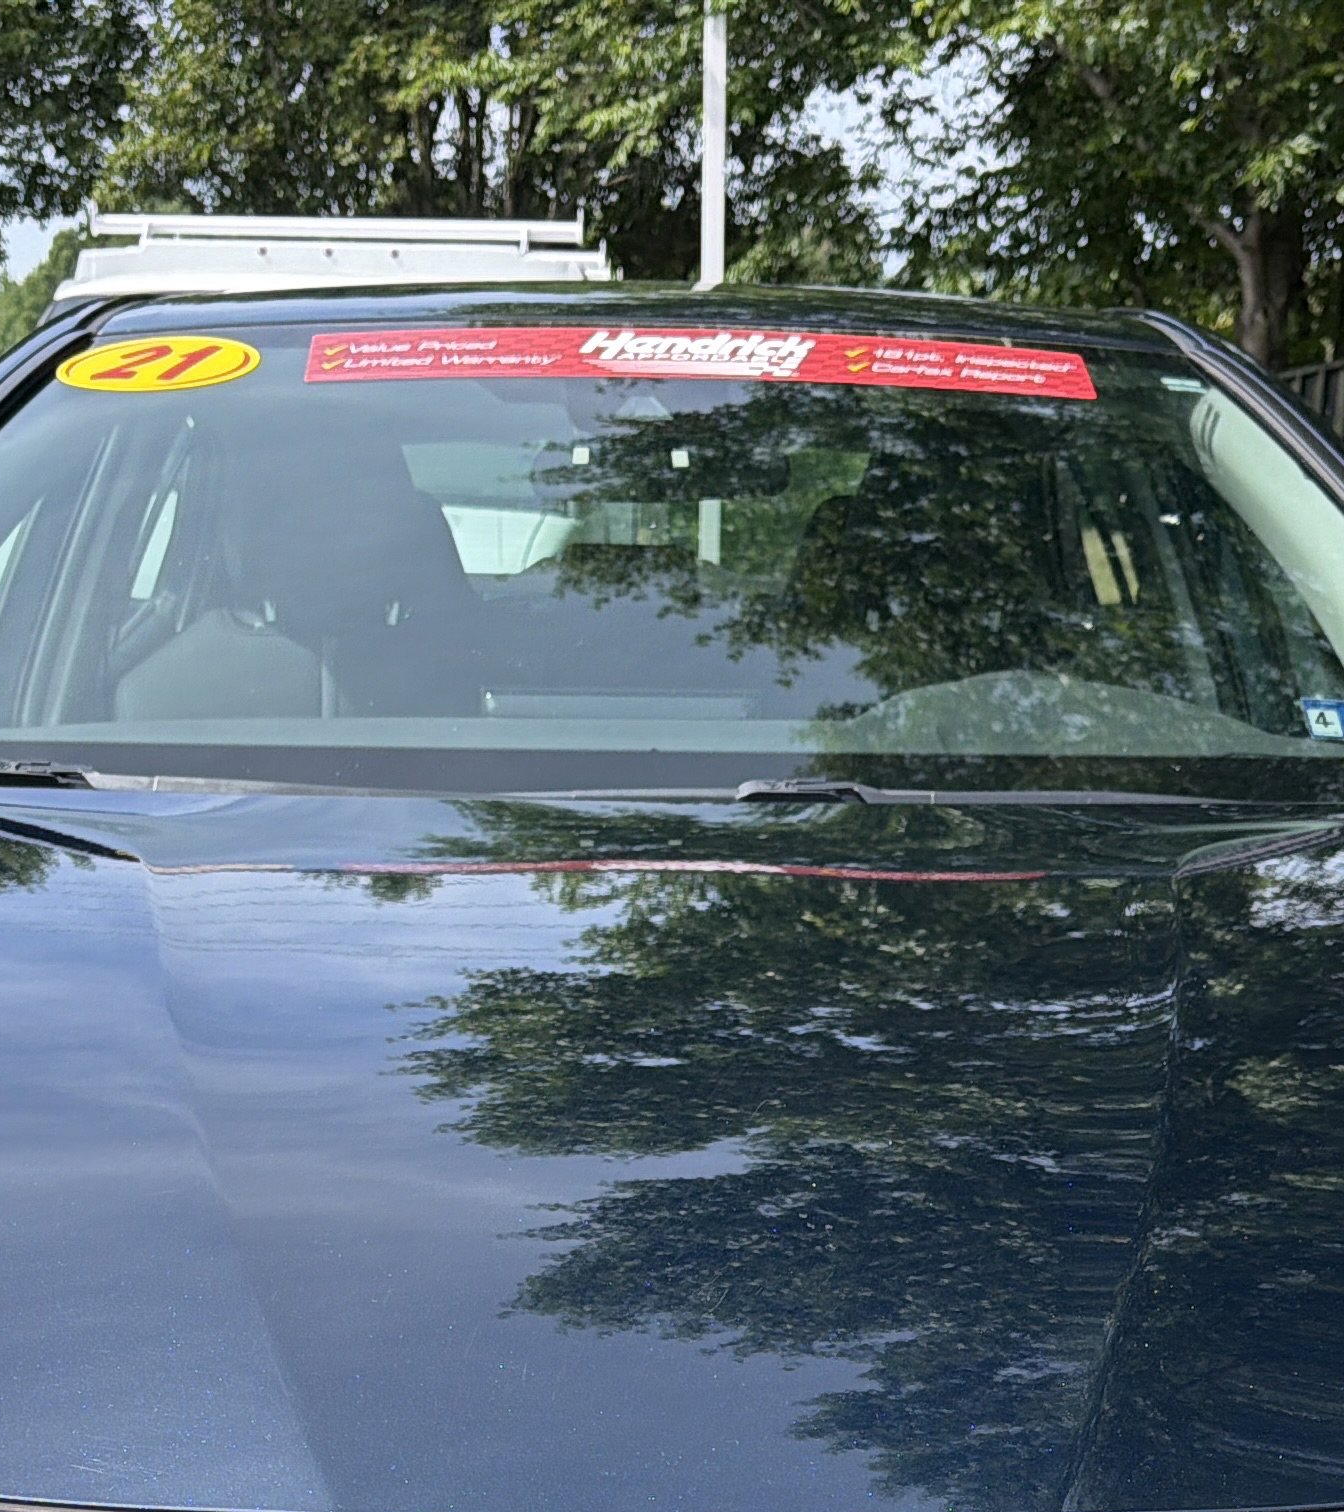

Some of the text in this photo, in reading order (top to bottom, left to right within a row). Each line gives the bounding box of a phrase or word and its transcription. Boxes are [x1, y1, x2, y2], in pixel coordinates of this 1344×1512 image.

[349, 339, 497, 354] Value Priced
[579, 330, 817, 360] Hendrick
[89, 345, 223, 380] 21
[343, 354, 434, 368] Limited
[871, 362, 1046, 384] Carfax Report
